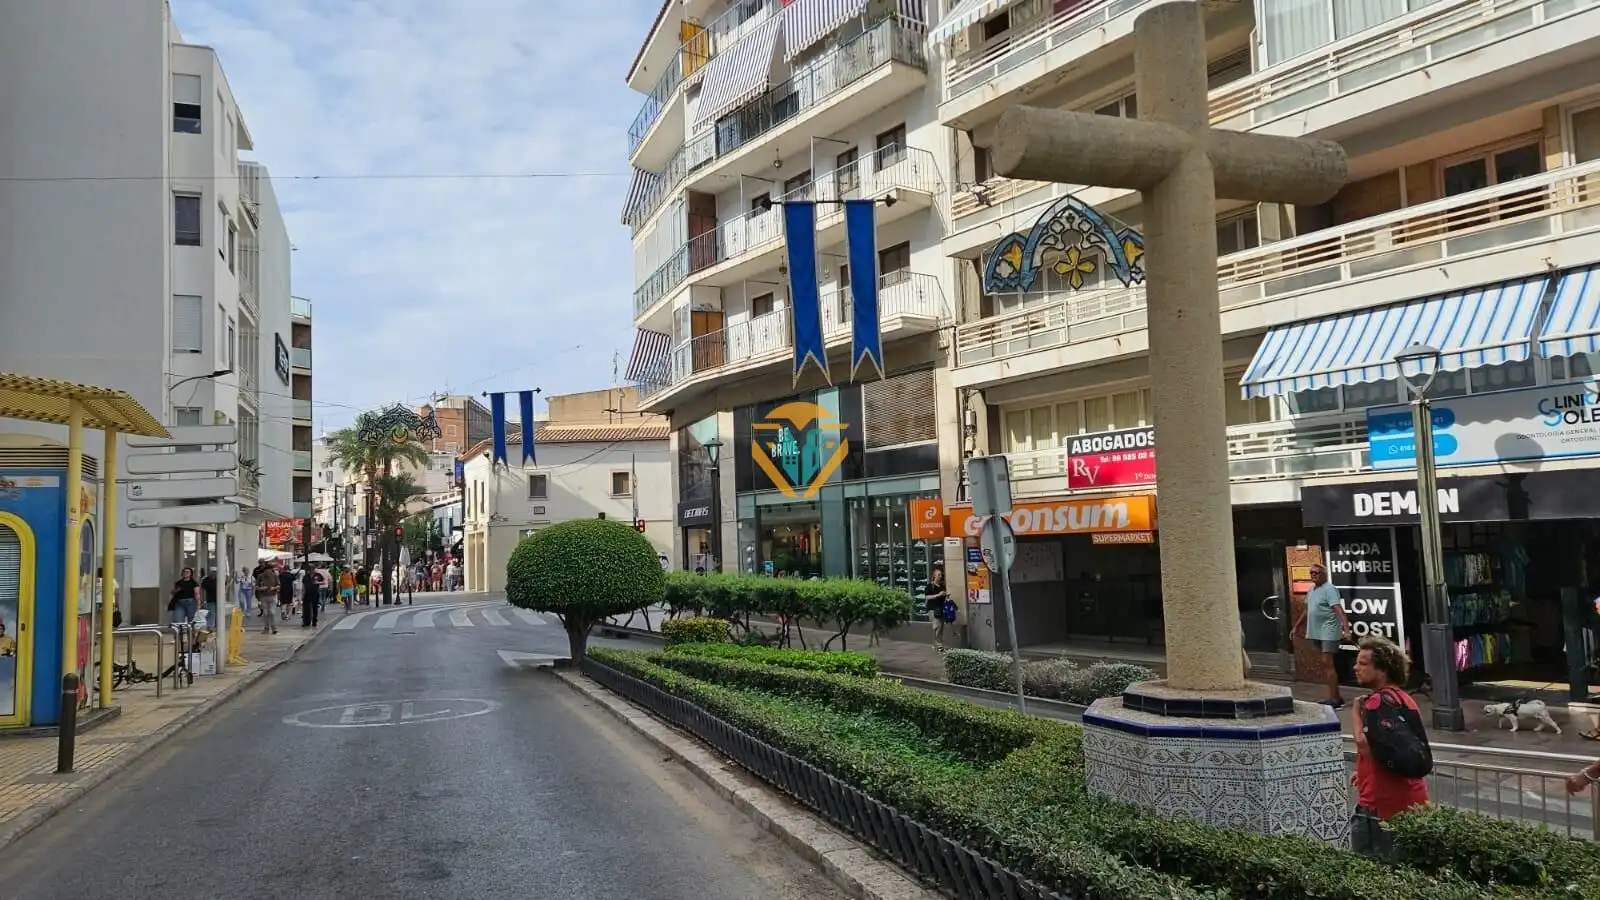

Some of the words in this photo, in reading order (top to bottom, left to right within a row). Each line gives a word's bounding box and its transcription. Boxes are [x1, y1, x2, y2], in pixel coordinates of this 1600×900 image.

[1071, 430, 1155, 454] ABOGADOS
[1353, 488, 1459, 517] DEMN
[1093, 532, 1153, 544] SUPERMARKET
[1339, 542, 1380, 556] MODA
[1331, 560, 1392, 573] HOMBRE
[1340, 598, 1388, 615] LOW
